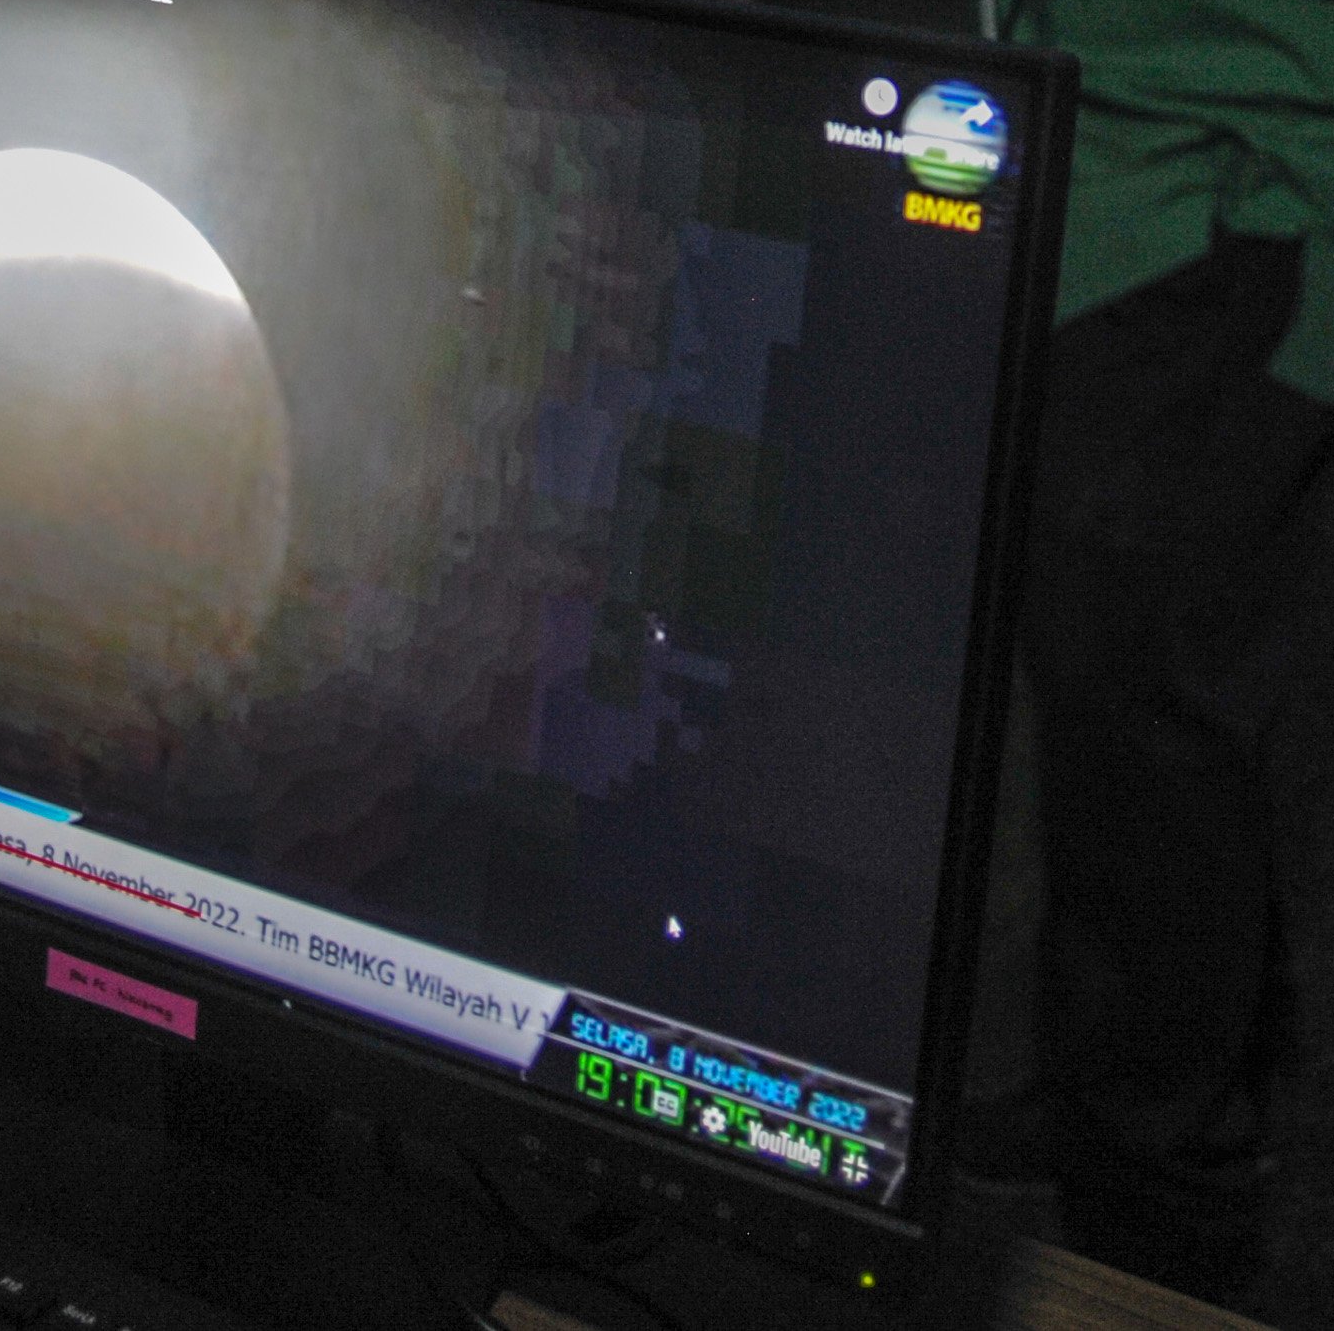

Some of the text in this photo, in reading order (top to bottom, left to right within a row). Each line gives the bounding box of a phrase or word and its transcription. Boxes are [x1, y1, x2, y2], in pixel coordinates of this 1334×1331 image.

[824, 121, 882, 150] Watch
[904, 190, 983, 233] BMKG
[63, 851, 175, 911] November
[184, 892, 246, 936] 2022.
[256, 915, 299, 953] Tim
[308, 934, 397, 986] BBMKG
[404, 966, 502, 1023] Wilayah
[512, 1003, 530, 1030] V
[694, 1053, 802, 1110] NOVEMBER
[808, 1091, 866, 1132] 2022
[748, 1119, 822, 1167] YouTube
